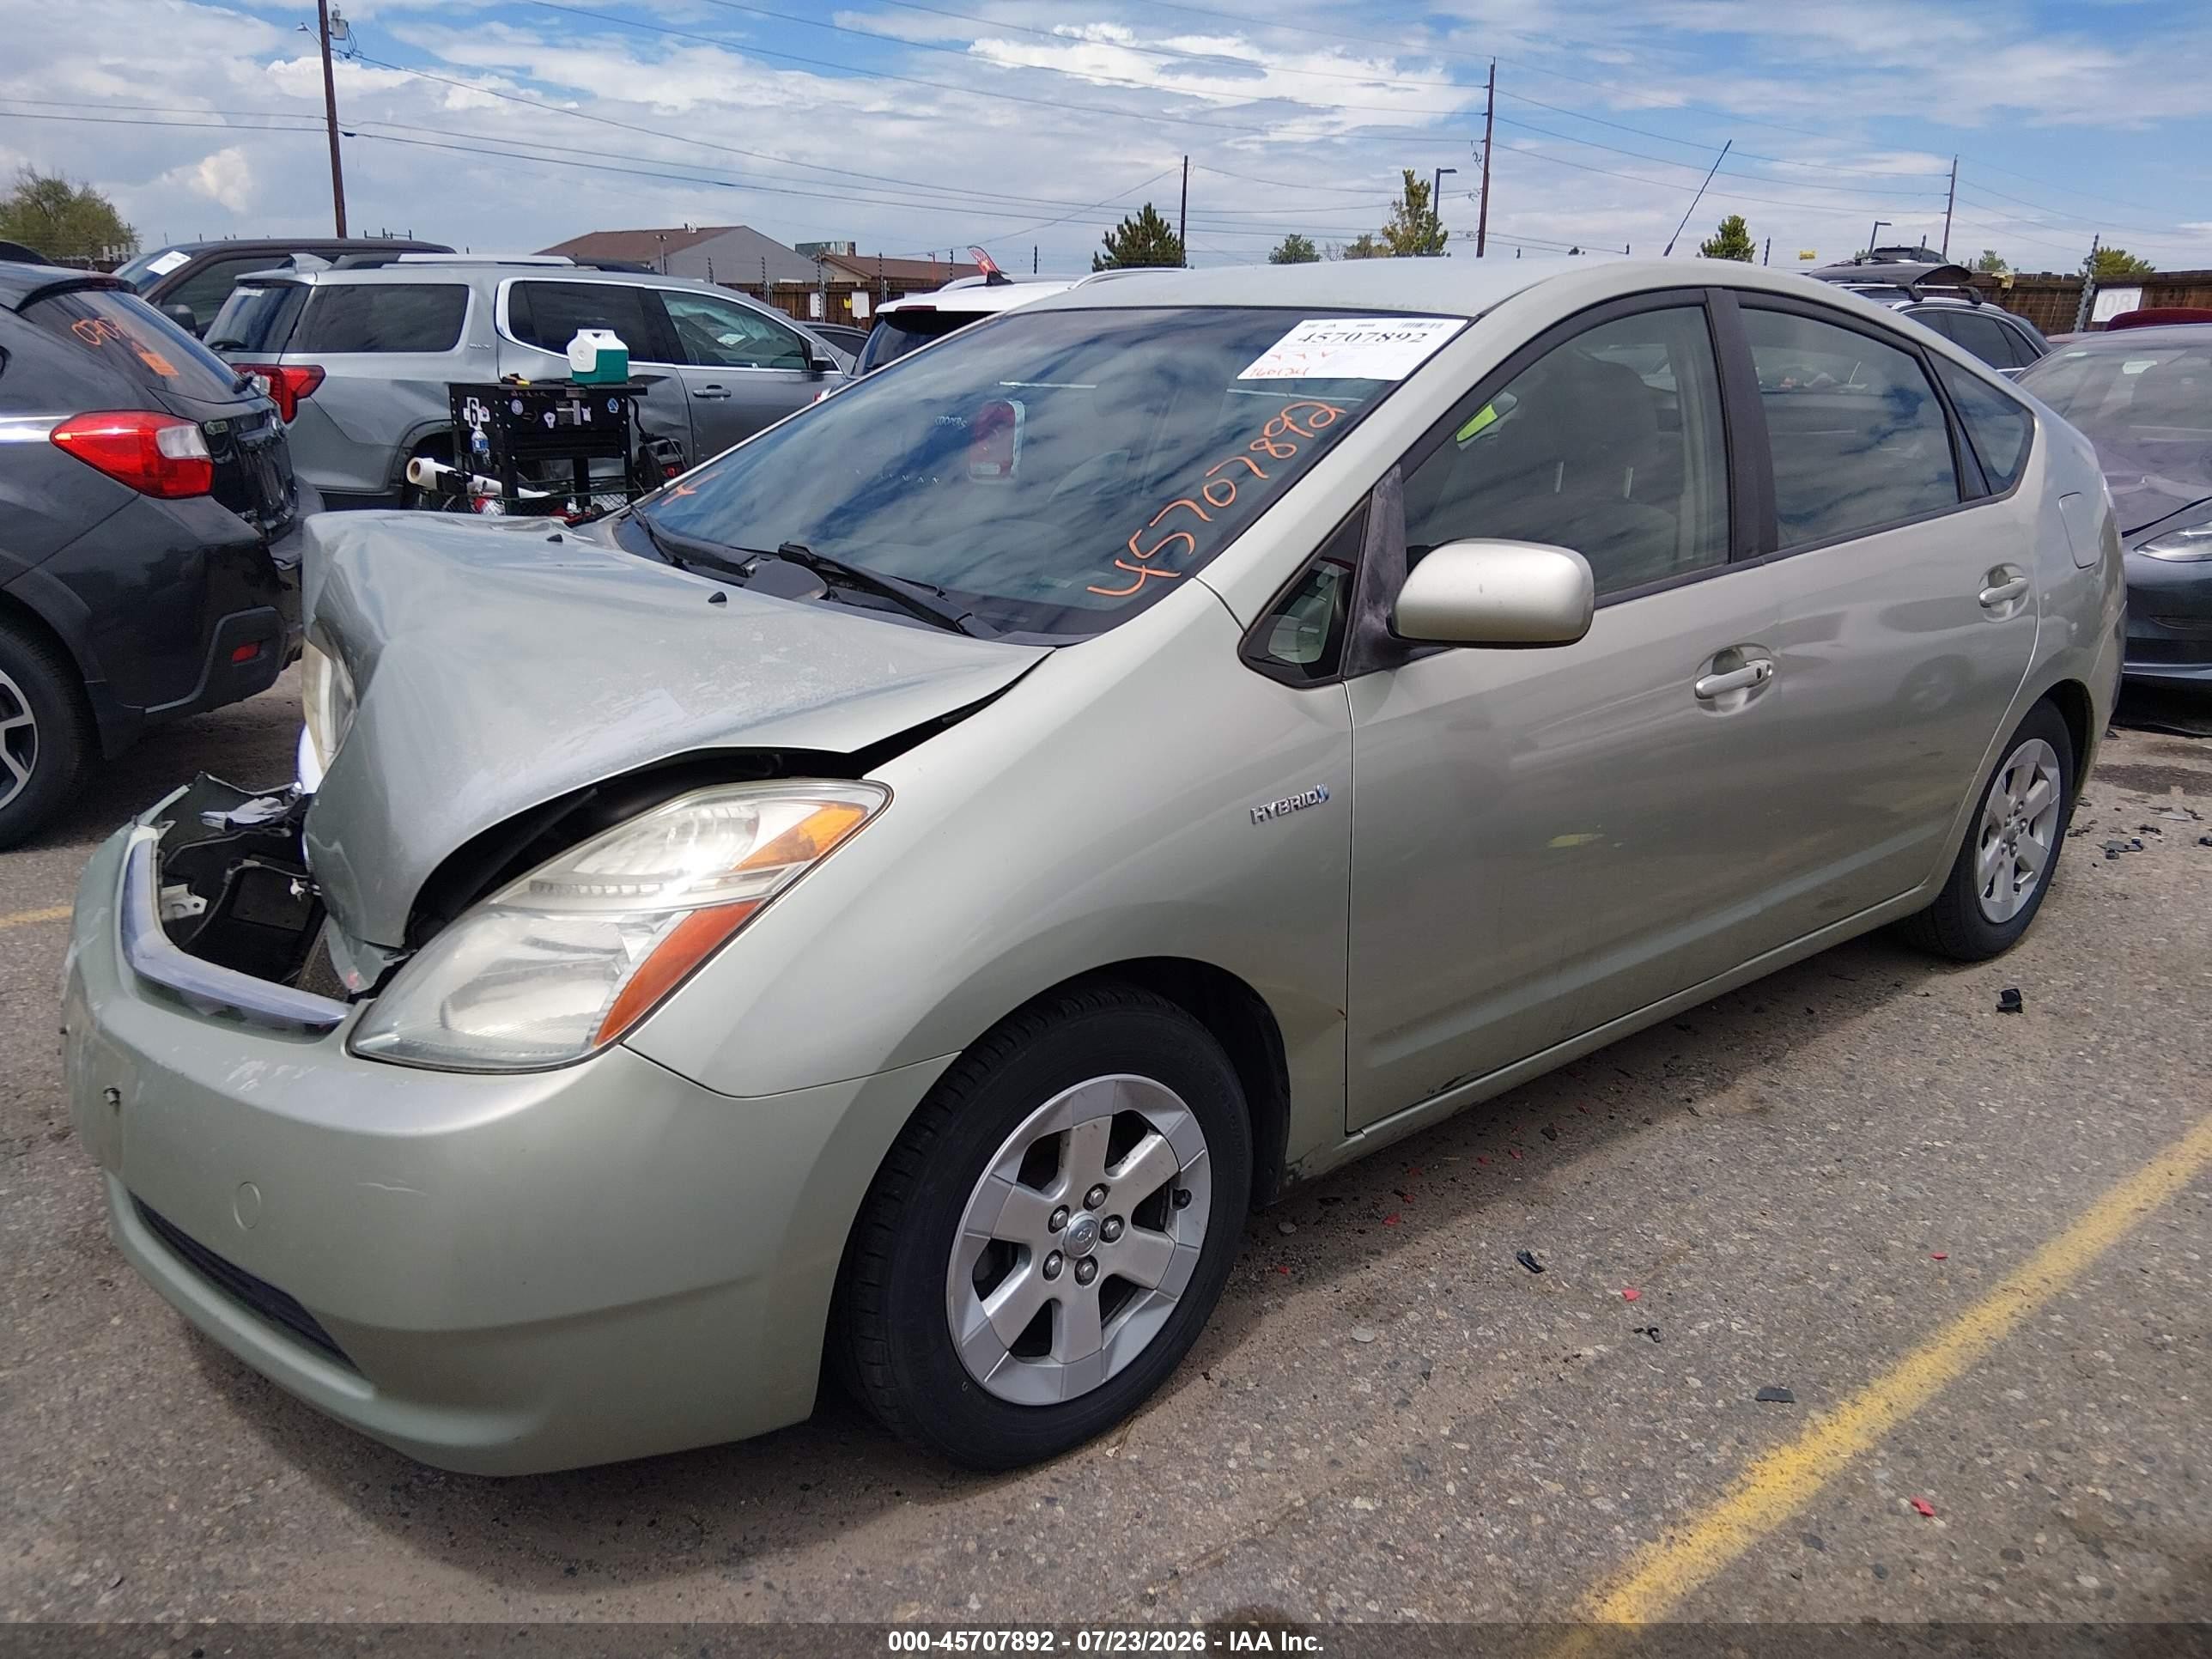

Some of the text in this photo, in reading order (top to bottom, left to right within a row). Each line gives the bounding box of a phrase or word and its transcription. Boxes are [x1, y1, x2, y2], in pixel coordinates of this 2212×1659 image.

[1298, 332, 1428, 343] 45707892
[469, 399, 478, 426] 6
[1086, 401, 1347, 597] 45707892
[1249, 790, 1318, 824] HYBRID
